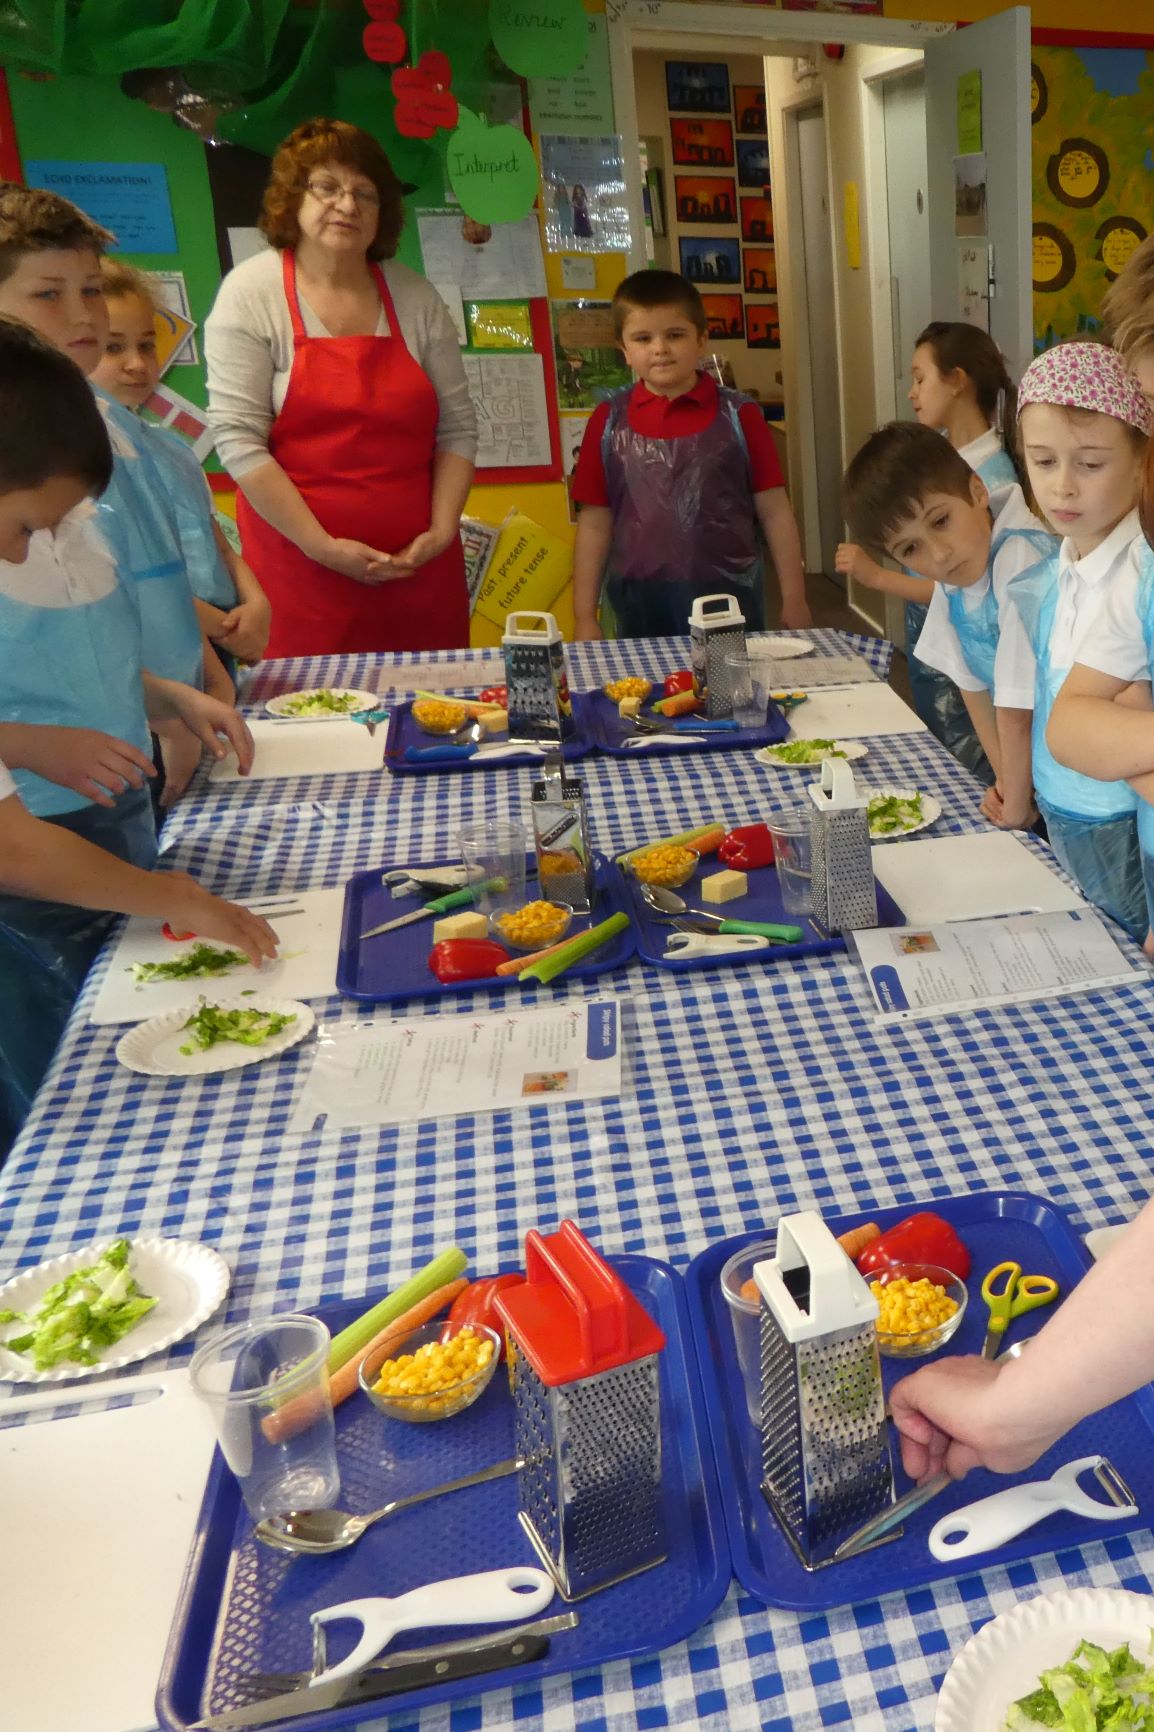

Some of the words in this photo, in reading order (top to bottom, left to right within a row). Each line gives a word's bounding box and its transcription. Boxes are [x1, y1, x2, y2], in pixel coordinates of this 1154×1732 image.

[44, 174, 72, 185] ECHO
[452, 151, 520, 182] Interpret
[523, 545, 550, 576] tense
